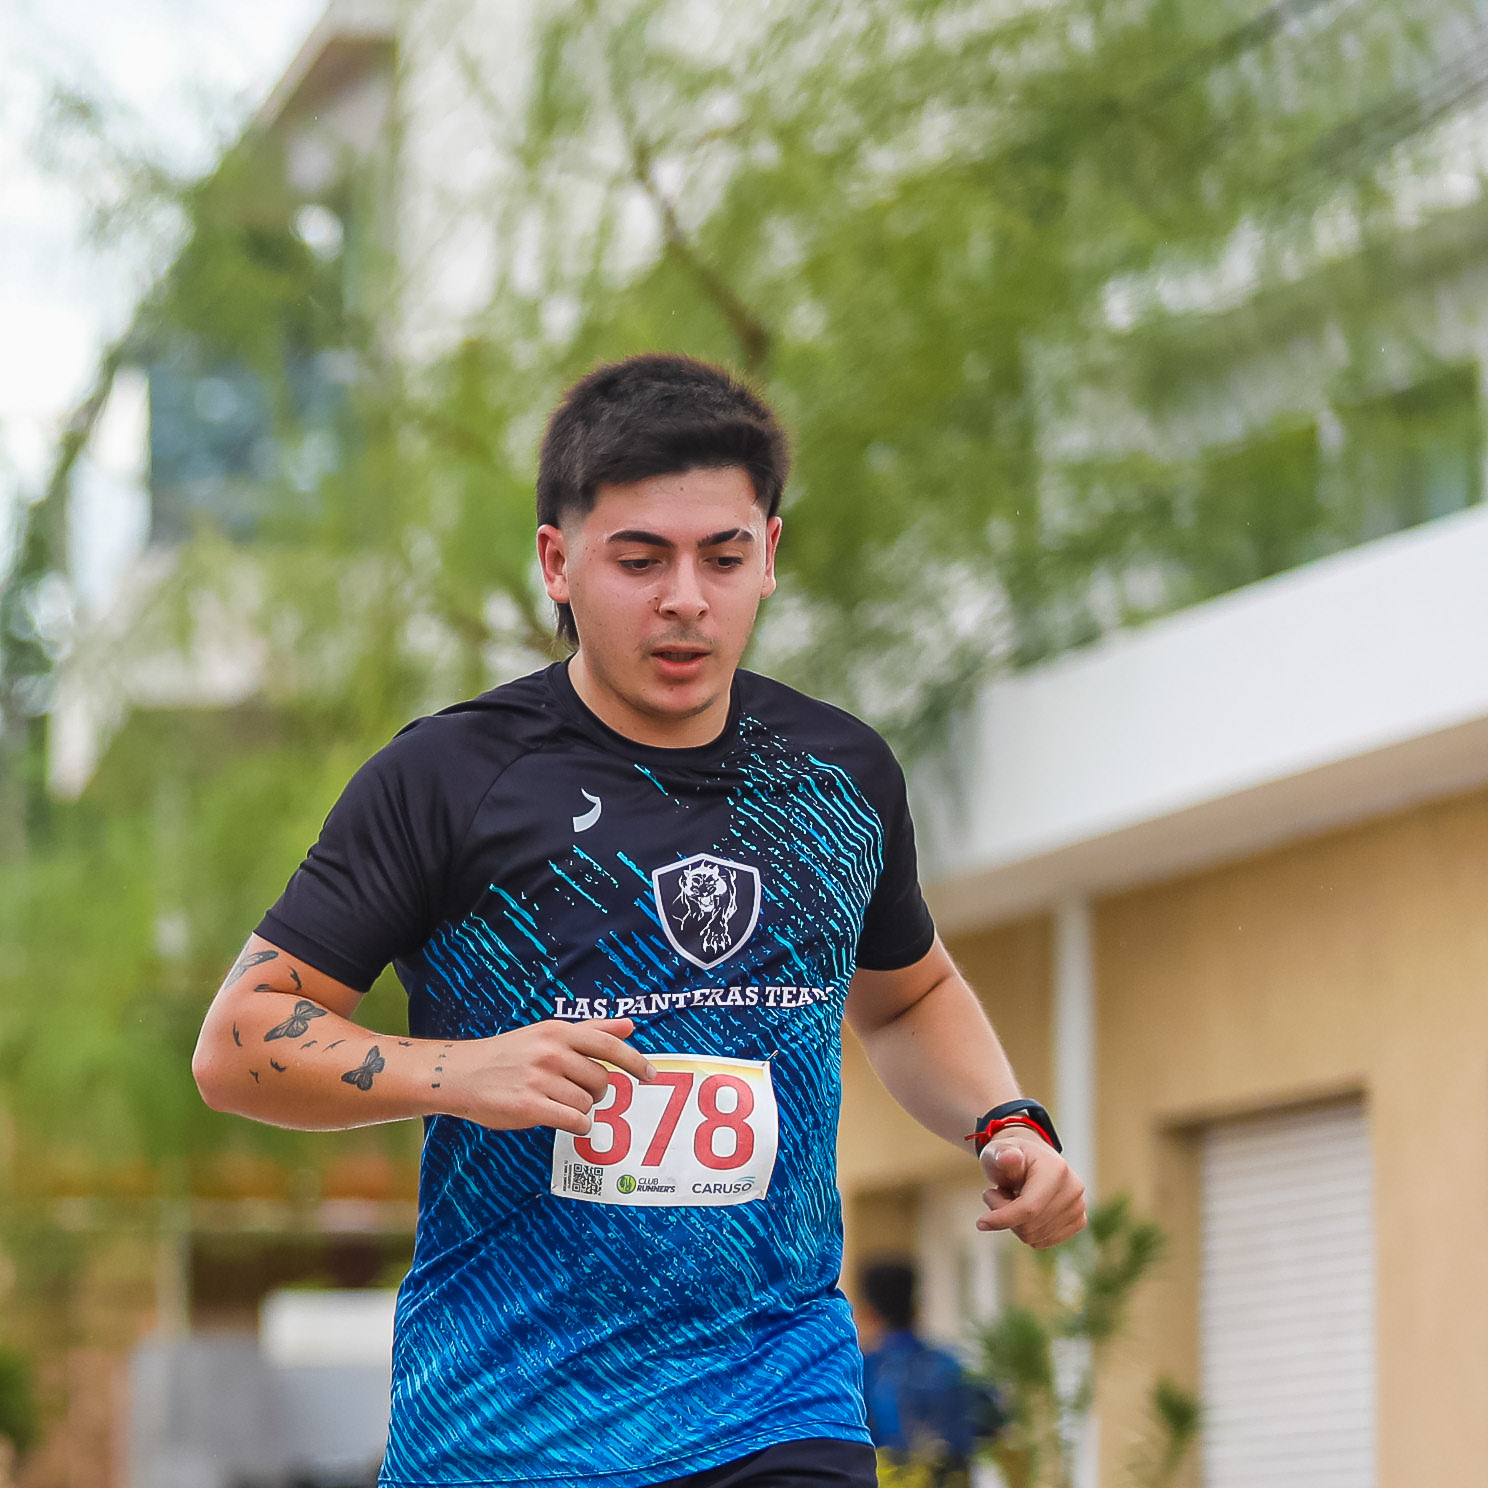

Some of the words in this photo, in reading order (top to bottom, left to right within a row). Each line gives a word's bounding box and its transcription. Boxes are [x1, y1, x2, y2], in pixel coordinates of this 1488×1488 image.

[554, 997, 608, 1019] LAS
[614, 986, 759, 1018] PANTERAS
[574, 1071, 755, 1170] 378
[638, 1177, 659, 1185] CLUB
[636, 1184, 676, 1193] RUNNER'S
[691, 1182, 752, 1194] CARUSO
